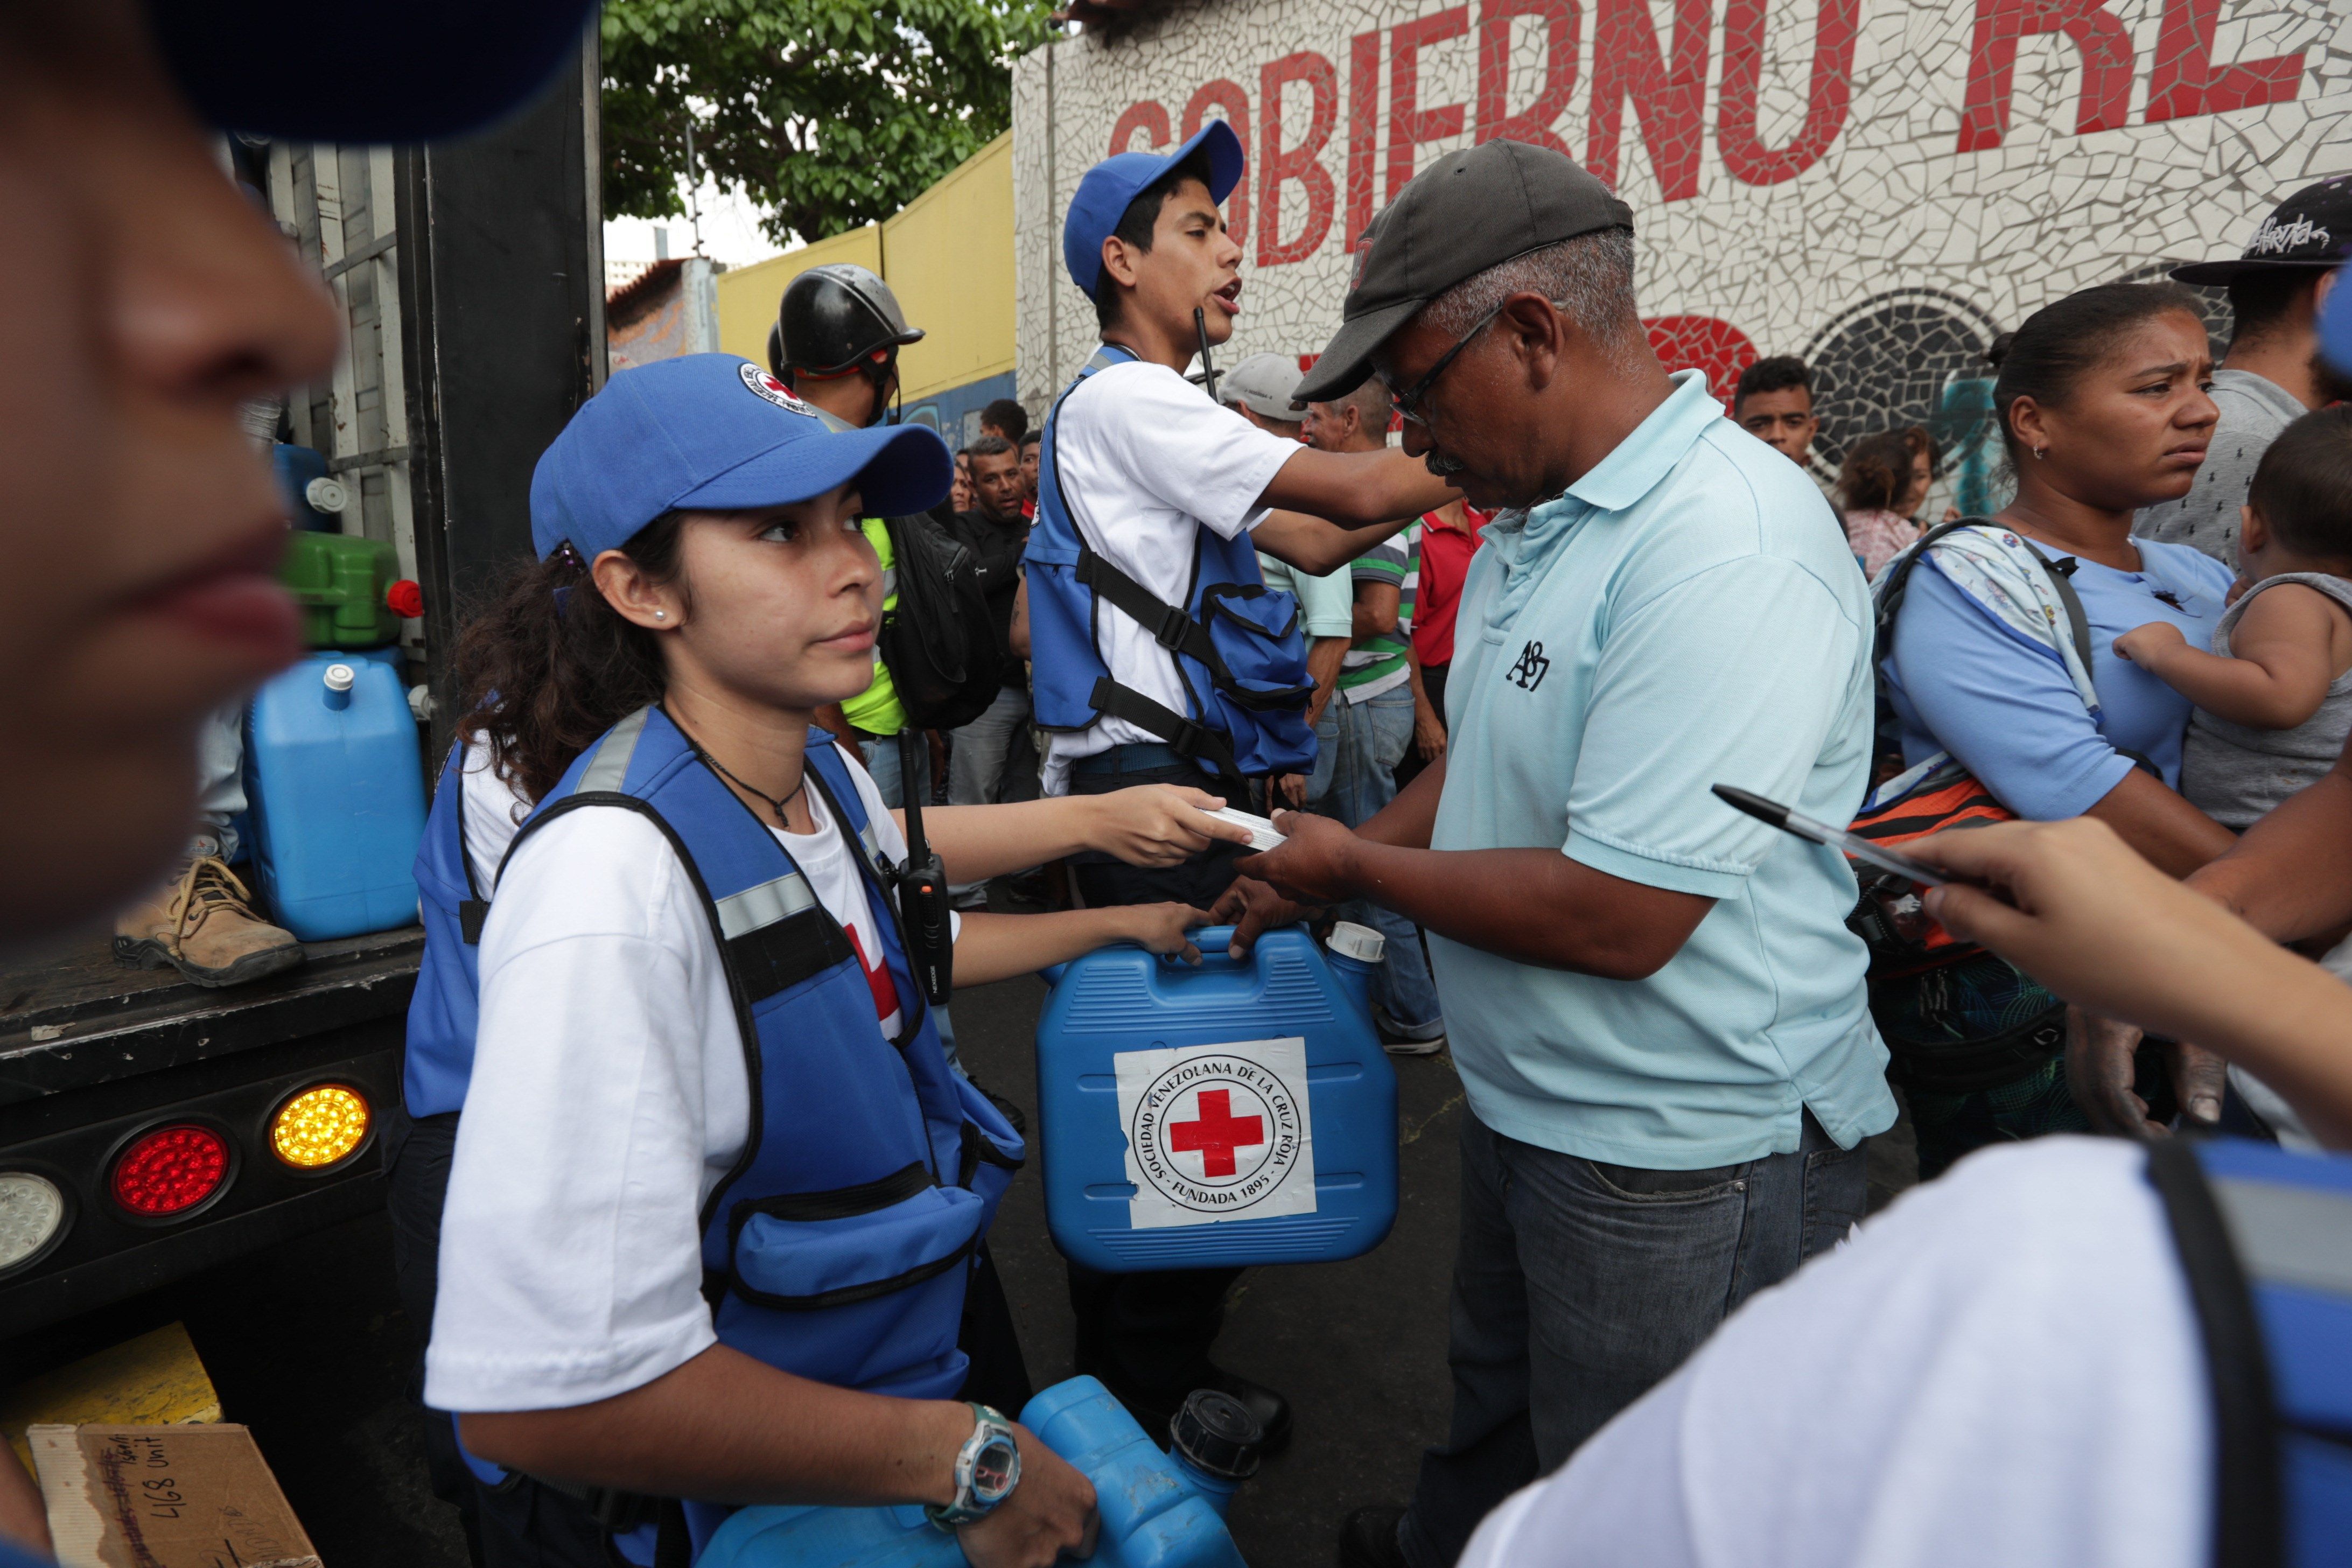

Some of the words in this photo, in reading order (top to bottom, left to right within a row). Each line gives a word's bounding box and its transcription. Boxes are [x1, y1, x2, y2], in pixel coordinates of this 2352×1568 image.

[1150, 1062, 1232, 1108] VENEZOLANA
[1237, 1066, 1257, 1081] DE
[1257, 1077, 1273, 1094] LA
[1272, 1095, 1293, 1130] CRUZ
[1140, 1112, 1167, 1179] SOCIEDAD
[1273, 1135, 1293, 1166] ROJA
[1172, 1181, 1237, 1204] FUNDADA
[1240, 1174, 1270, 1198] 1895
